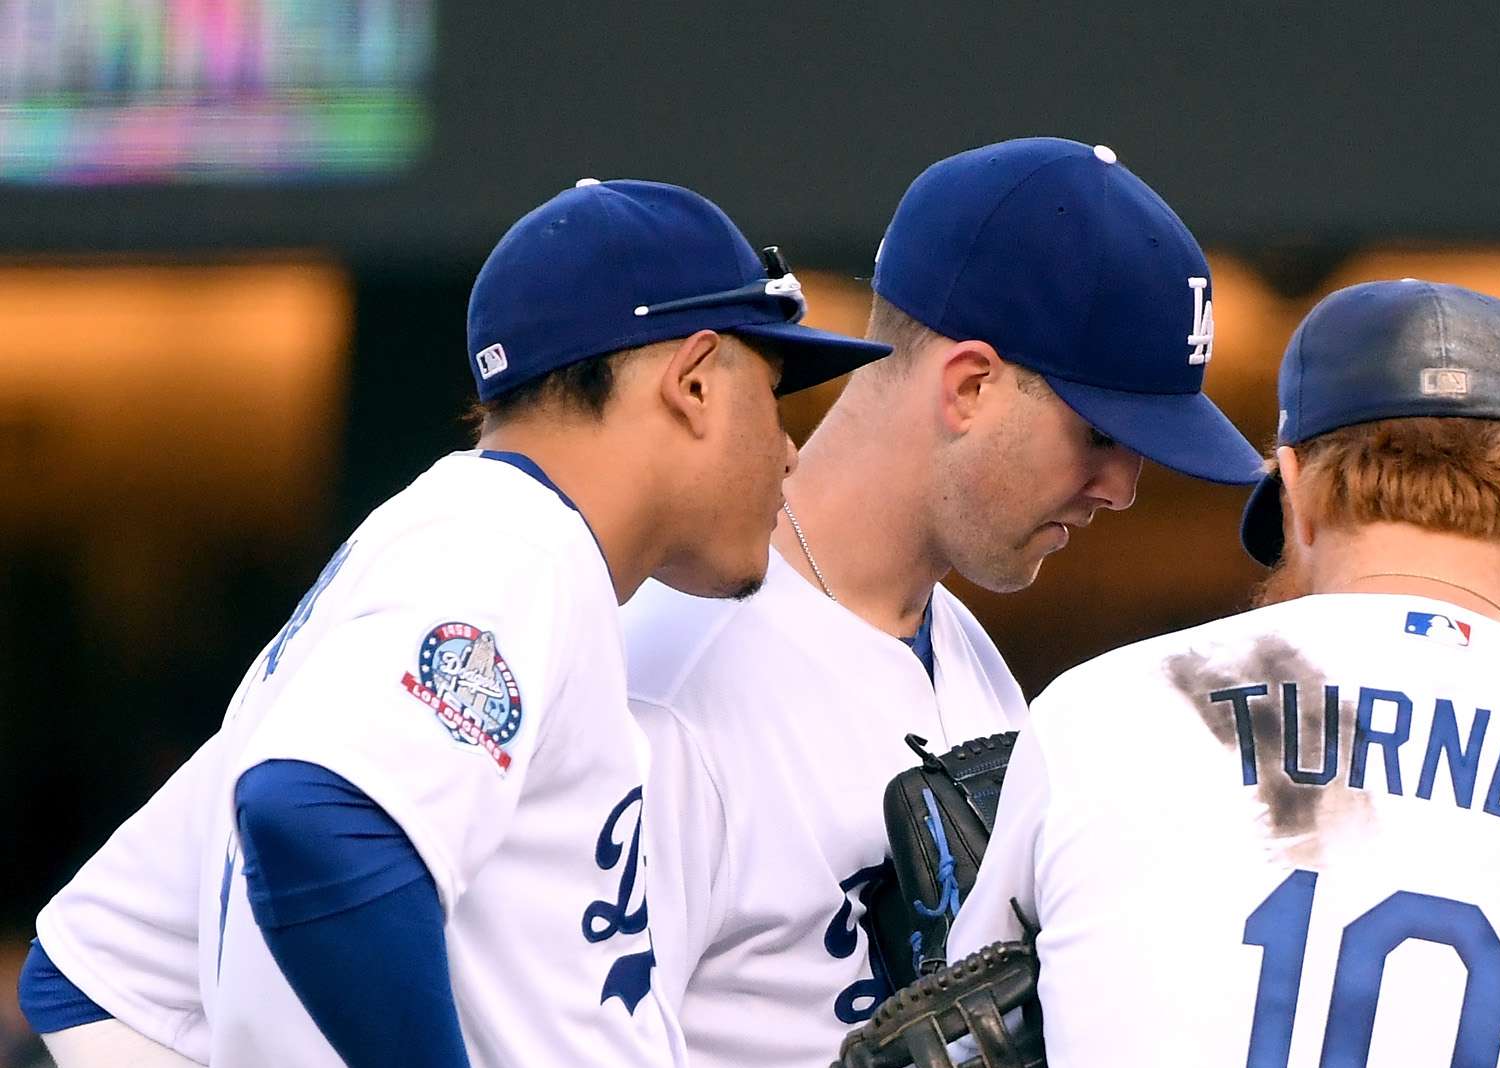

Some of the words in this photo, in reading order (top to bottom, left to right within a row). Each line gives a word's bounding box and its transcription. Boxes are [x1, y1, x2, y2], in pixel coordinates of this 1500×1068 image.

[1187, 276, 1215, 365] LA
[442, 623, 472, 638] 1958
[412, 684, 441, 709] LOS
